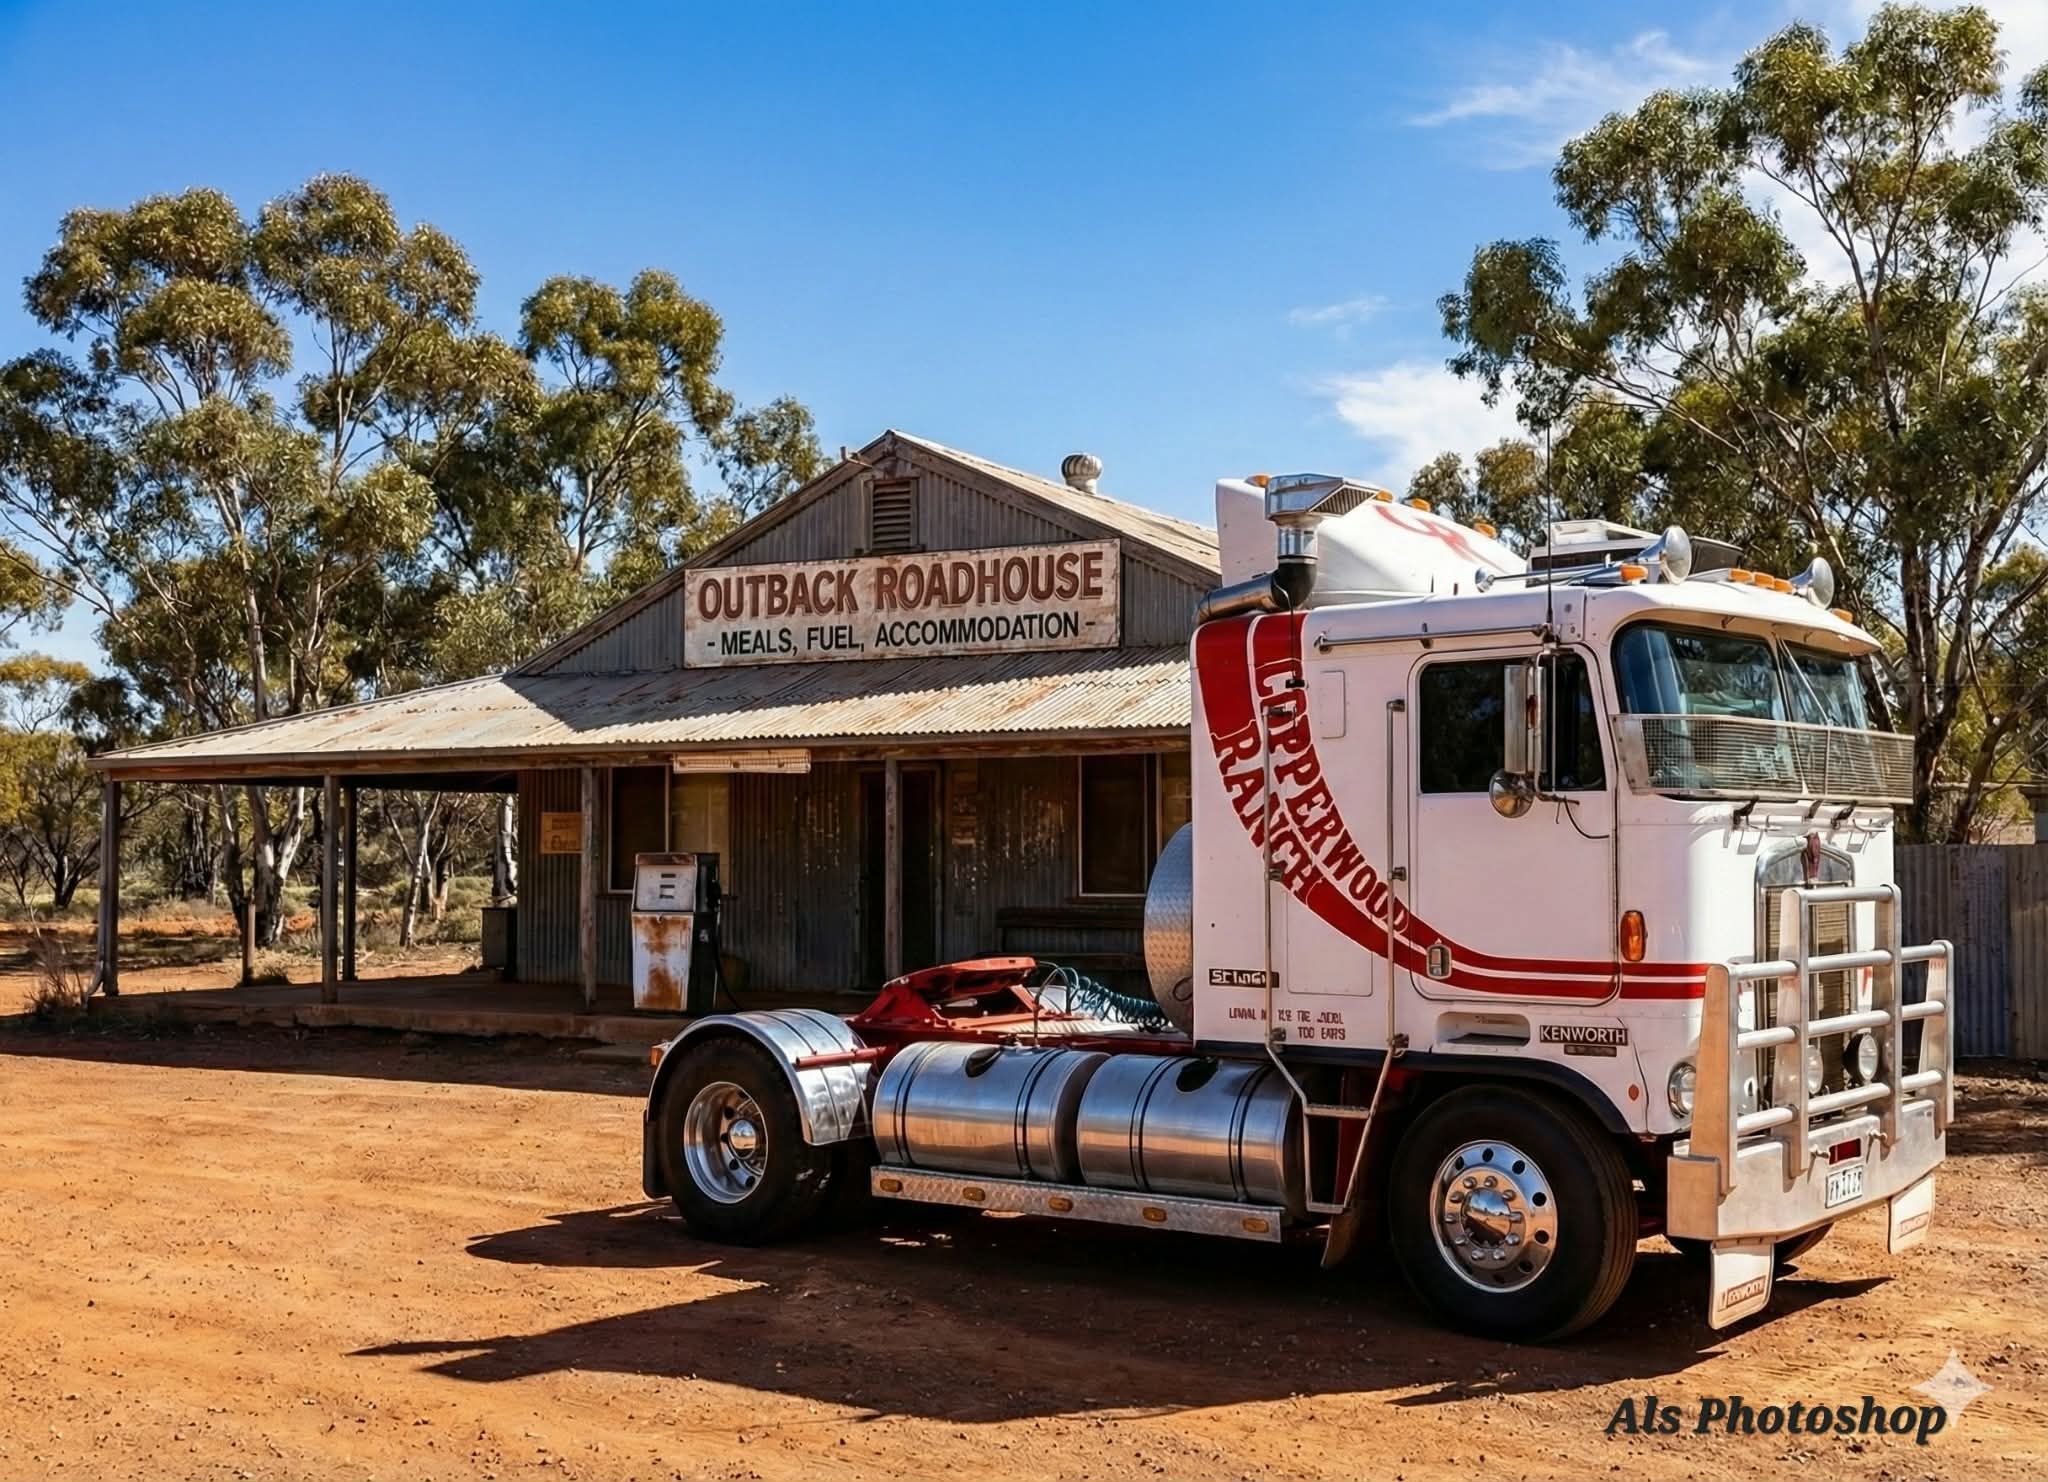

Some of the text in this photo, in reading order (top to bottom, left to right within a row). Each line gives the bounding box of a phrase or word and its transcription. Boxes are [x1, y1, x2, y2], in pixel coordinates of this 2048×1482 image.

[700, 552, 1104, 621] OUTBACK ROADHOUSE
[806, 624, 865, 652] FUEL,
[874, 611, 1079, 648] ACCOMMODATION
[1211, 722, 1325, 904] RANCH
[1540, 1026, 1626, 1044] KENWORTH
